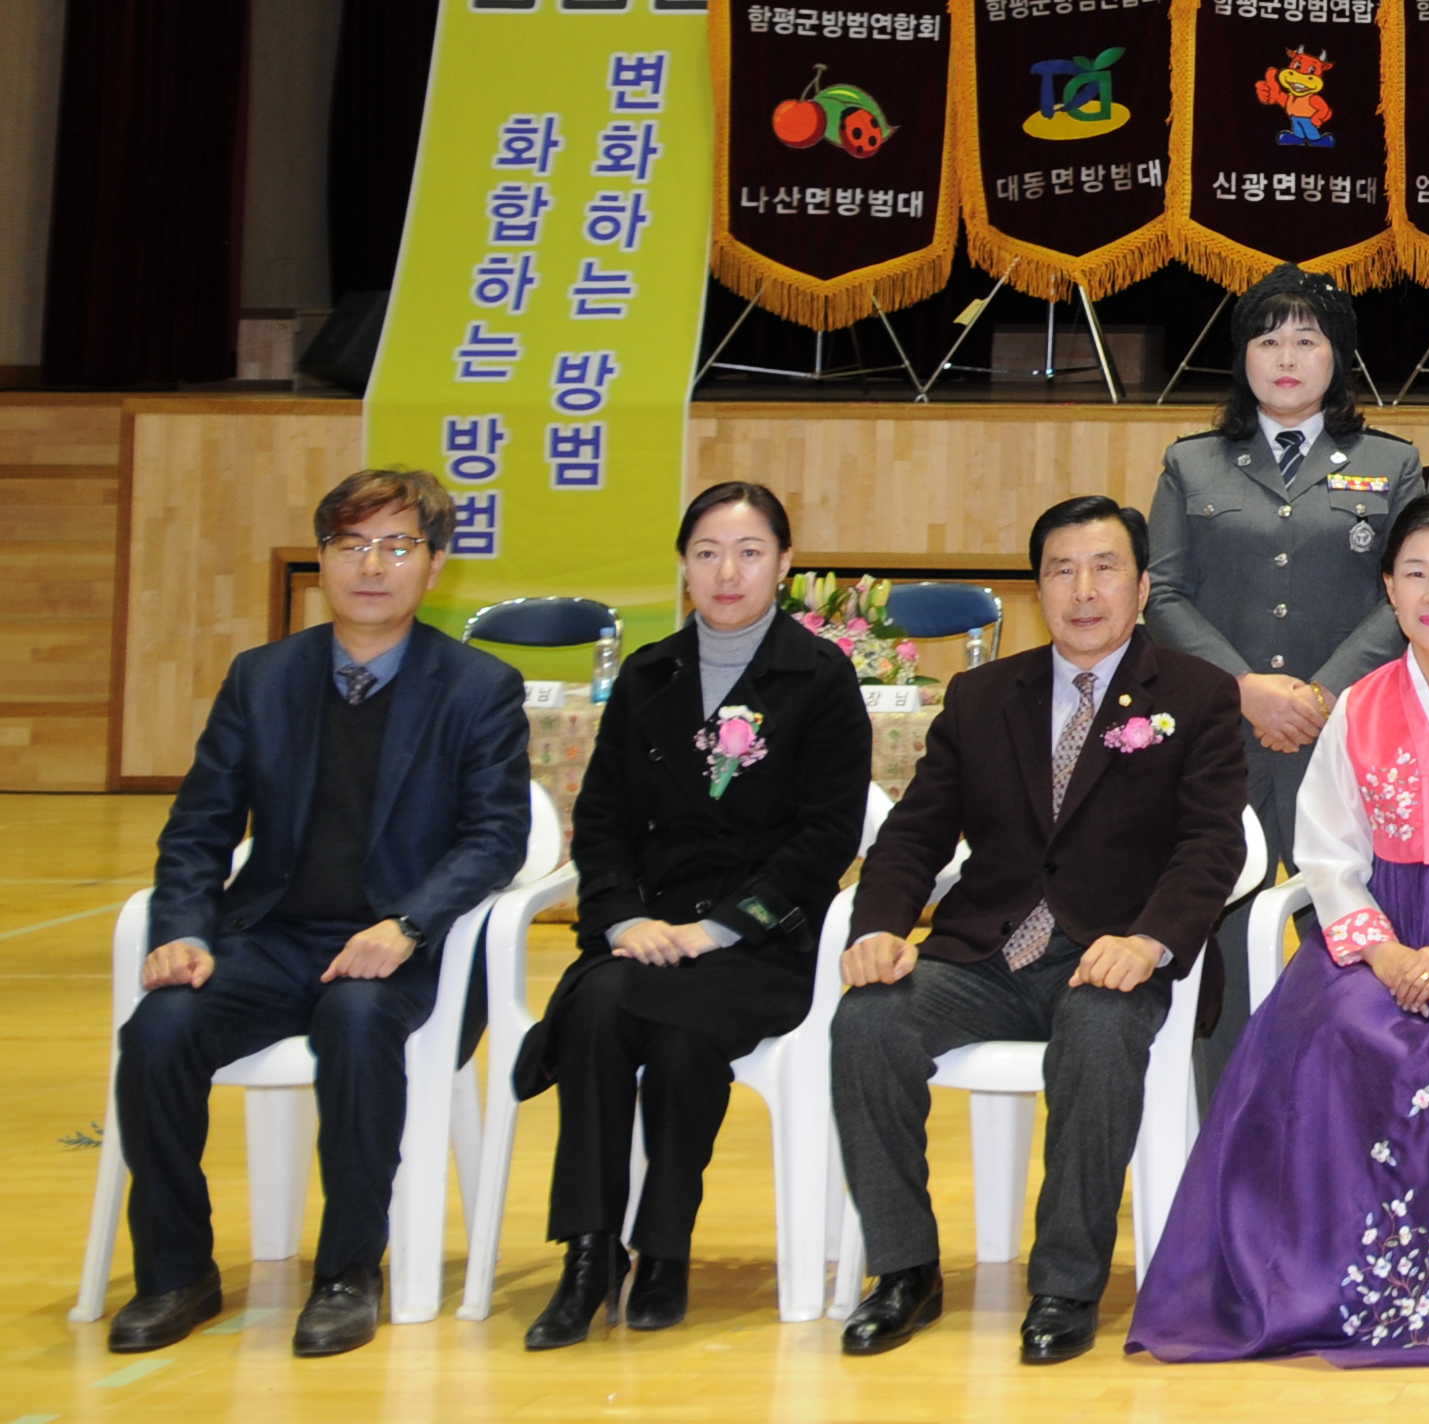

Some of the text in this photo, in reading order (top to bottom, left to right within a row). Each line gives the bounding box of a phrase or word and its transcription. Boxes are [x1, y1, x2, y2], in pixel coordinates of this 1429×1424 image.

[747, 5, 941, 41] 함평군방범연합회
[996, 159, 1163, 202] 대동면방범대
[1212, 171, 1378, 205] 신광면방범대
[740, 186, 924, 218] 나산면방범대
[549, 53, 665, 488] 변화하는 방범
[444, 115, 561, 556] 화합하는 방범
